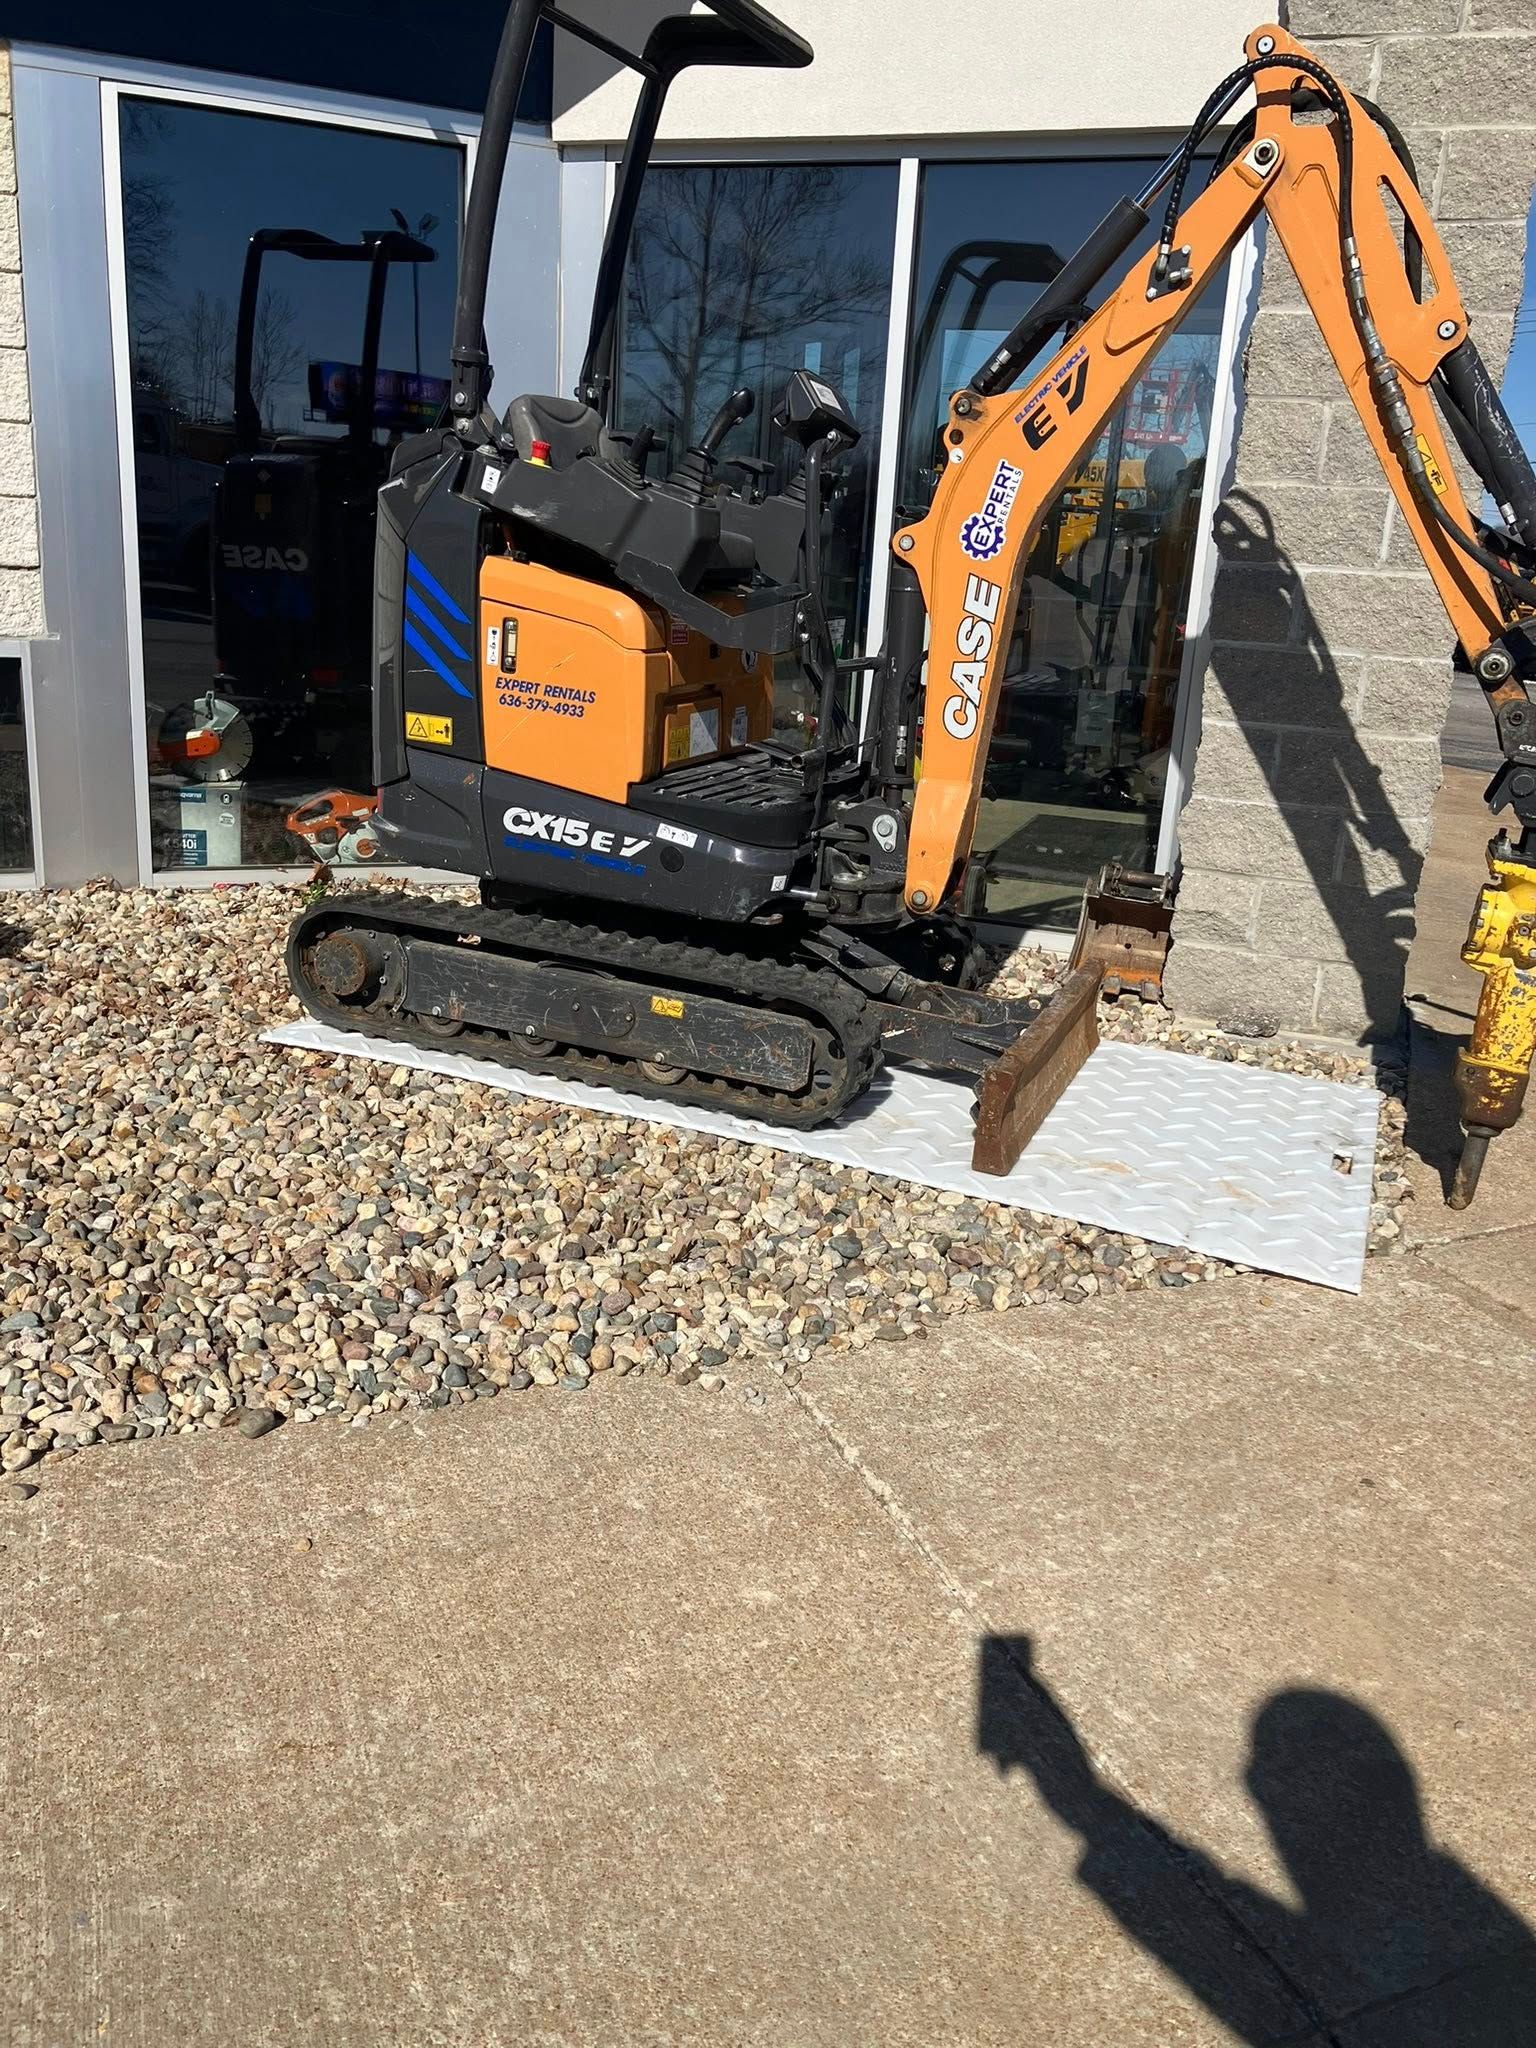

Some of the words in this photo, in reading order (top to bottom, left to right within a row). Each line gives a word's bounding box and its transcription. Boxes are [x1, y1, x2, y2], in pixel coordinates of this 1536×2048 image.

[1014, 382, 1053, 424] ELECTRIC
[1051, 345, 1088, 383] VEHICLE
[973, 461, 1015, 547] EXPERT
[997, 469, 1022, 525] RENTALS
[943, 572, 1002, 740] CASE
[495, 676, 541, 695] EXPERT
[543, 684, 597, 704] RENTALS
[498, 693, 585, 718] 636-379-4933
